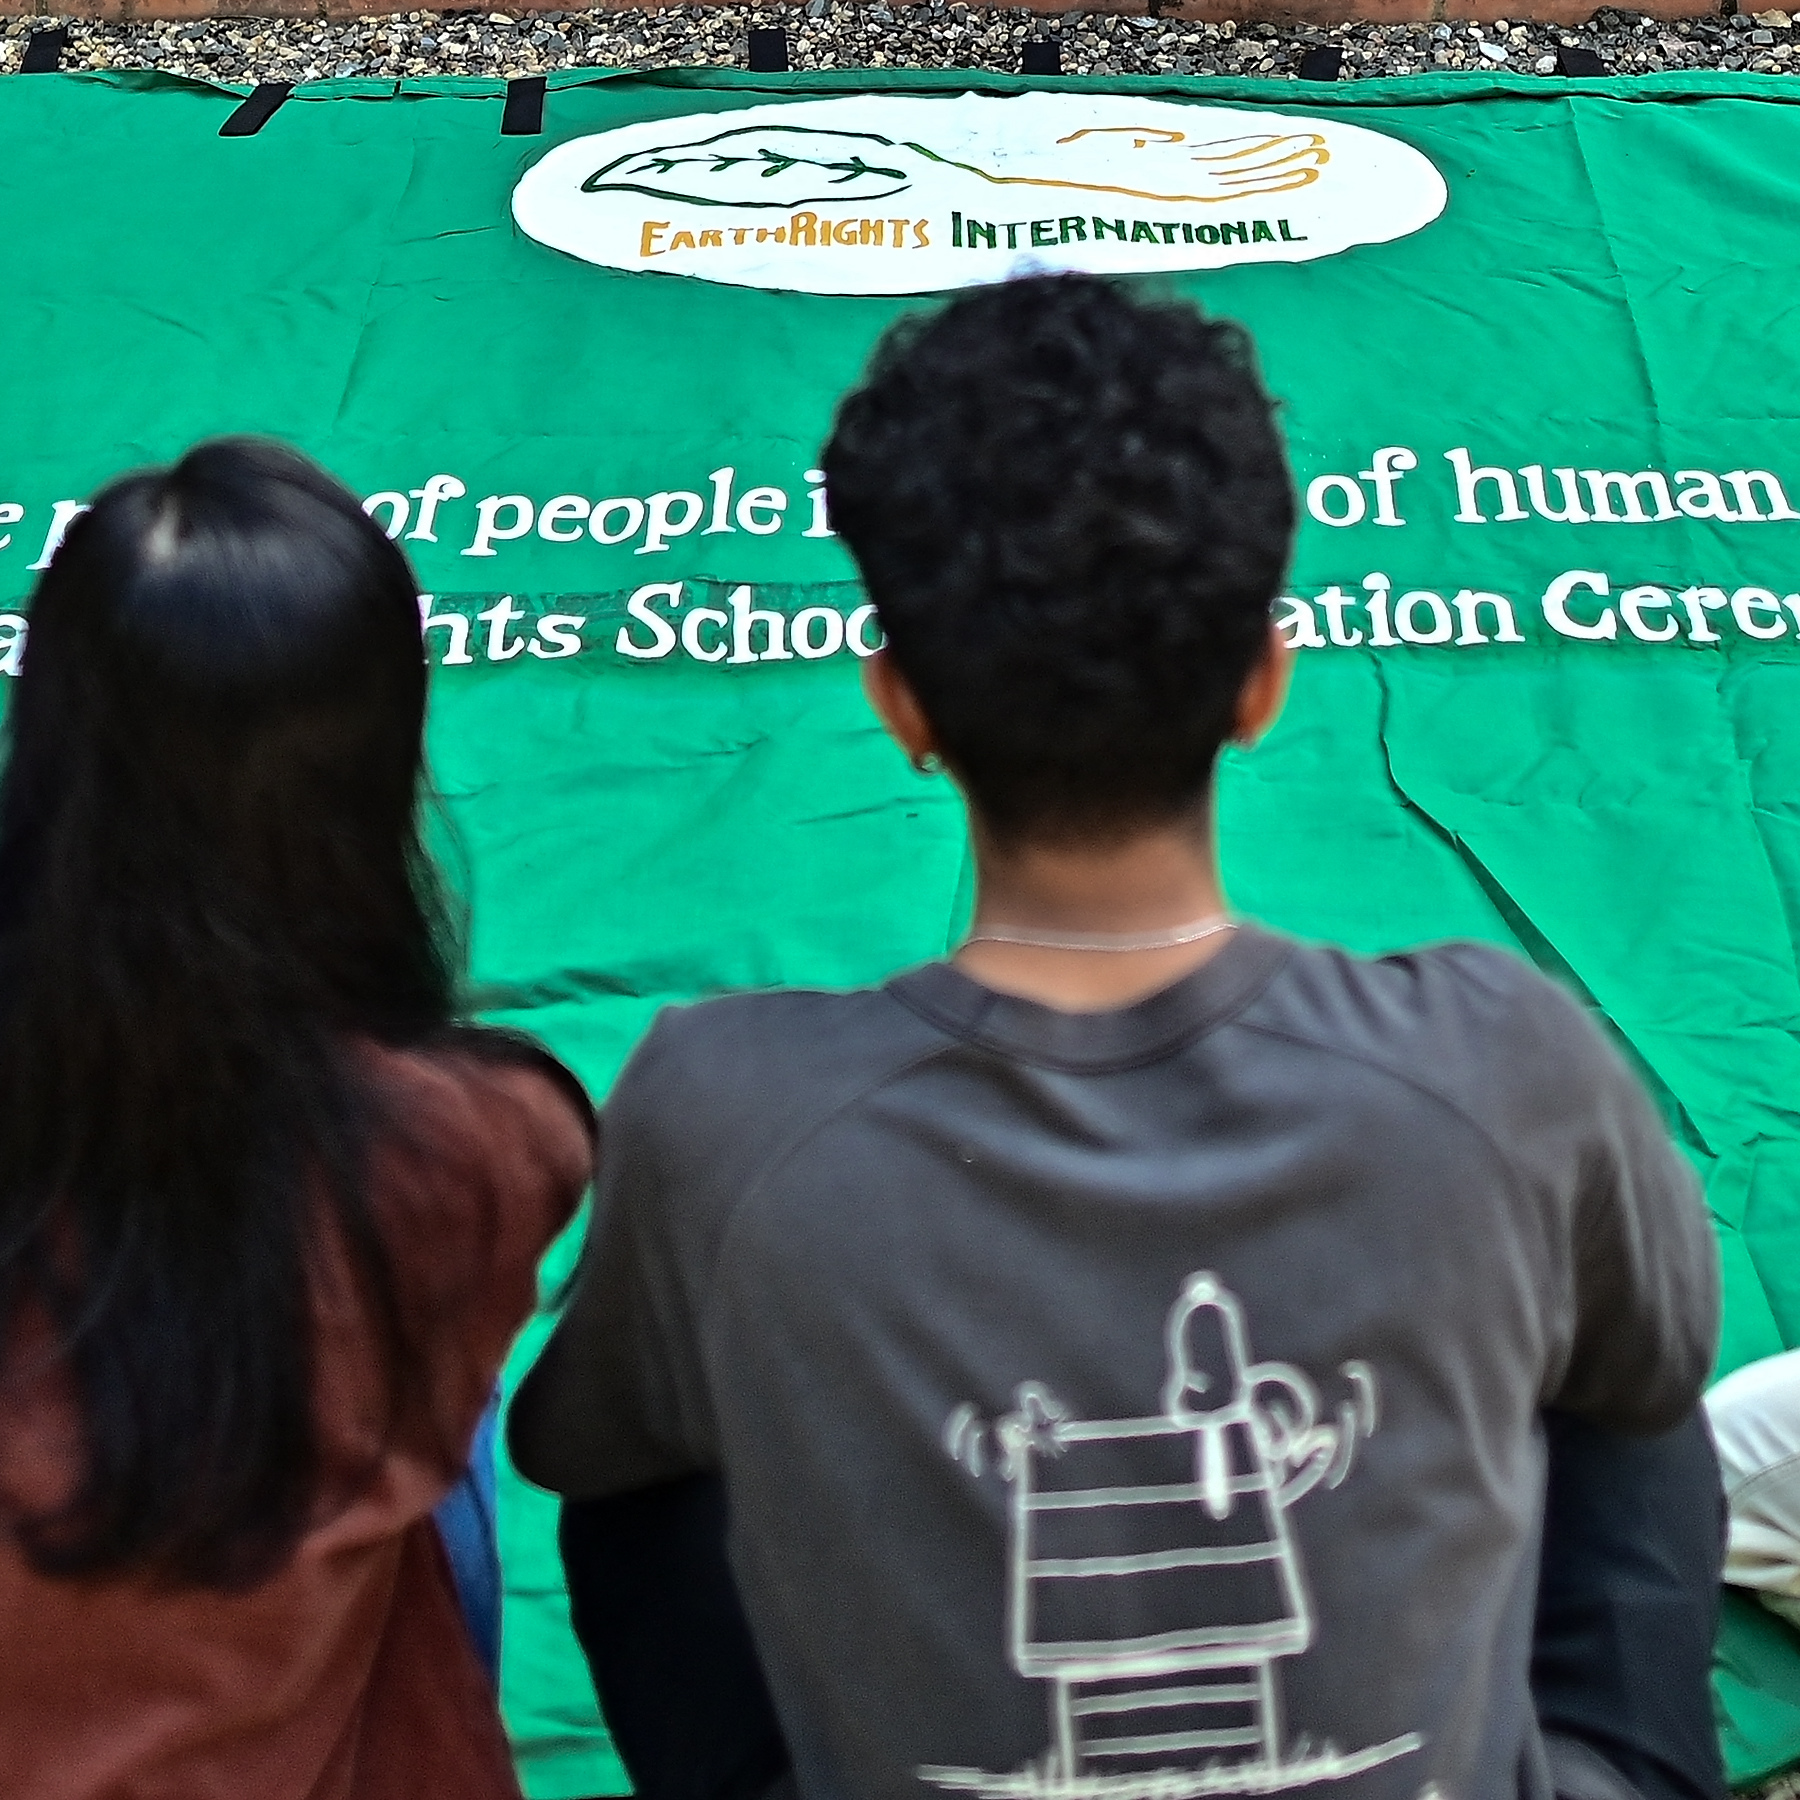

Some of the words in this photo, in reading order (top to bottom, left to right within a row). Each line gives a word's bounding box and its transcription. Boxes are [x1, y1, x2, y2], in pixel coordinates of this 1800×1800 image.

[459, 466, 788, 557] people
[1306, 446, 1418, 527] of
[615, 580, 888, 664] Schoo
